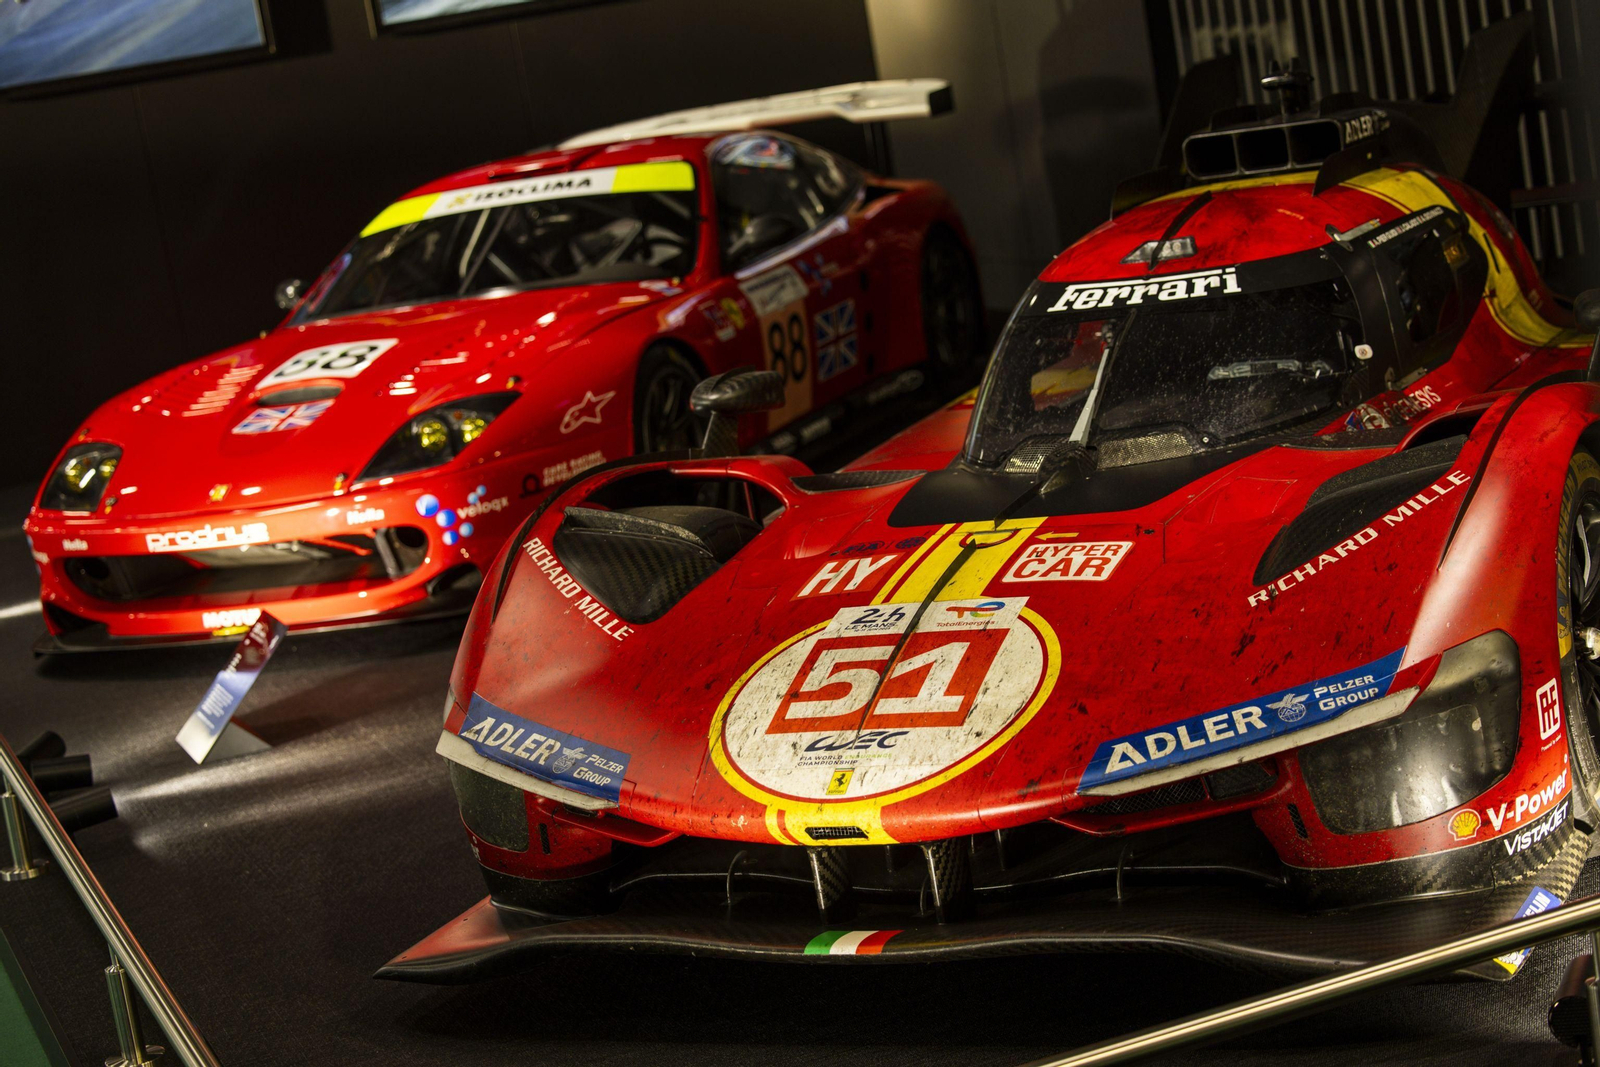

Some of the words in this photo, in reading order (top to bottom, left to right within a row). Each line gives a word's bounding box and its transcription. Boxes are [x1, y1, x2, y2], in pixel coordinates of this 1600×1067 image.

[1344, 114, 1374, 144] ADLER
[1047, 267, 1241, 313] Ferrari
[274, 345, 379, 378] 88
[769, 313, 807, 388] 88
[456, 496, 509, 520] veloqx
[145, 522, 270, 552] prodrive
[1026, 544, 1123, 558] HYPER
[1247, 527, 1379, 608] RICHARD
[1382, 470, 1472, 527] MILLE
[797, 554, 898, 597] HY
[1012, 557, 1112, 578] CAR
[522, 537, 582, 599] RICHARD
[574, 595, 635, 641] MILLE
[202, 608, 261, 628] MOTU
[936, 620, 995, 628] TotalEnergies
[784, 642, 971, 720] 51
[1313, 674, 1376, 699] PELZER
[1318, 687, 1380, 711] GROUP
[461, 716, 561, 765] ADLER
[804, 731, 910, 752] WEC
[1104, 705, 1267, 774] ADLER
[573, 766, 611, 787] GROUP
[585, 754, 624, 774] PELZER
[1486, 767, 1568, 832] V-Power
